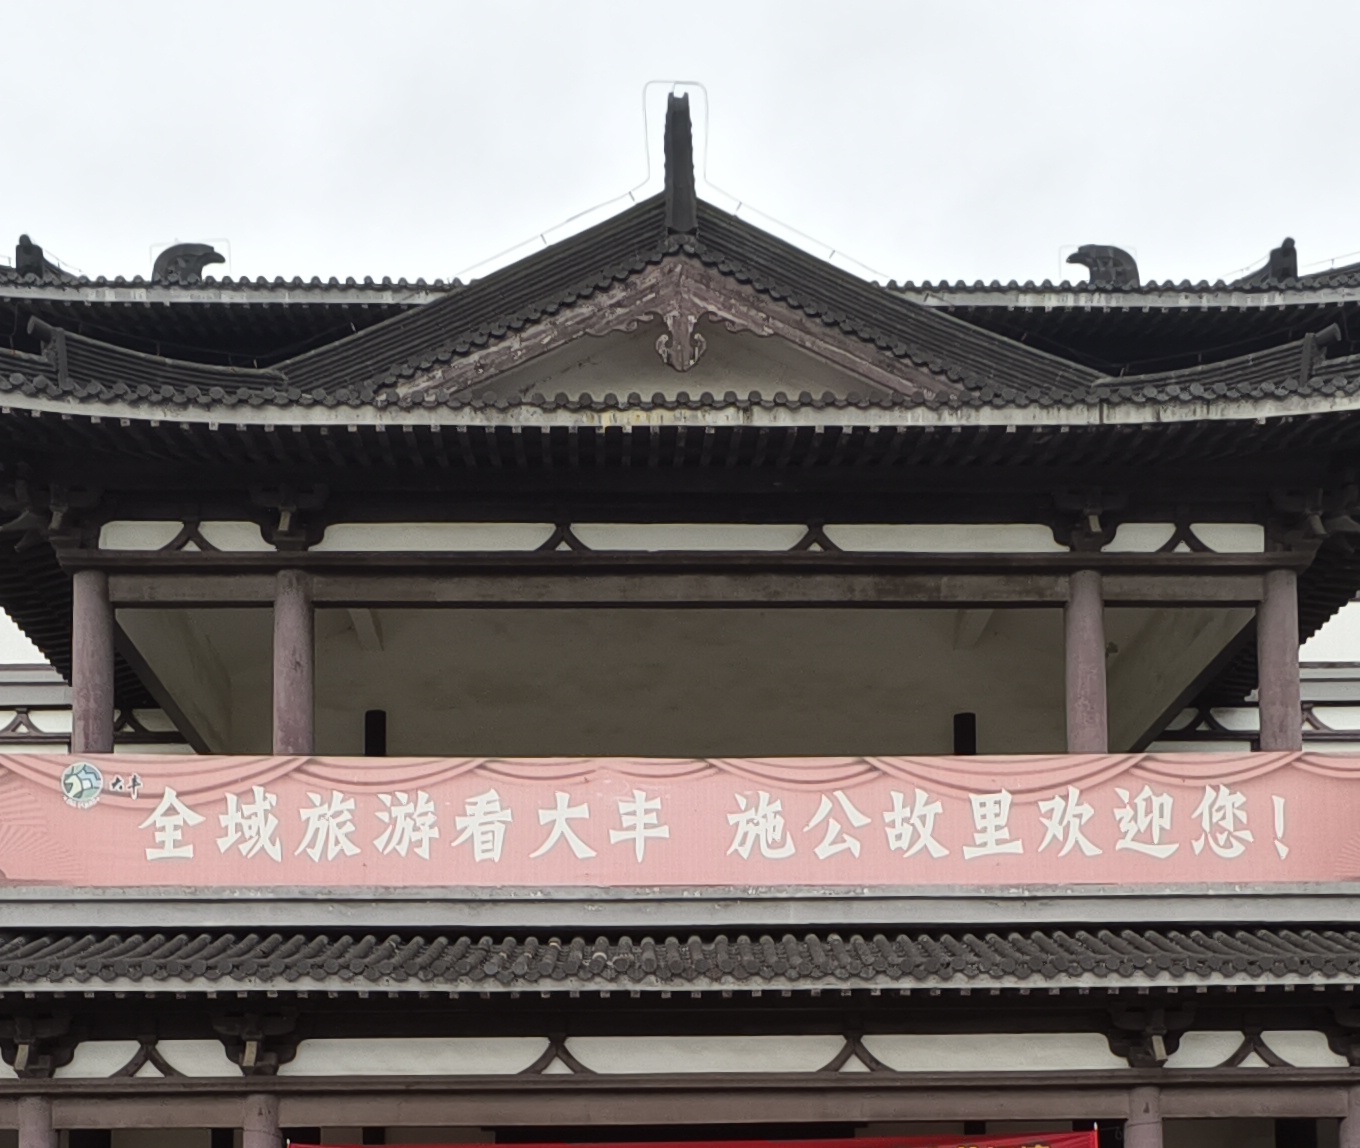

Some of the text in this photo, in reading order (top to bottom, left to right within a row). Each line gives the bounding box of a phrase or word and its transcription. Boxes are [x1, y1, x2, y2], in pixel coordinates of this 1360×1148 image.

[139, 785, 1291, 863] 全域旅游看大丰 施公故里欢迎您！
